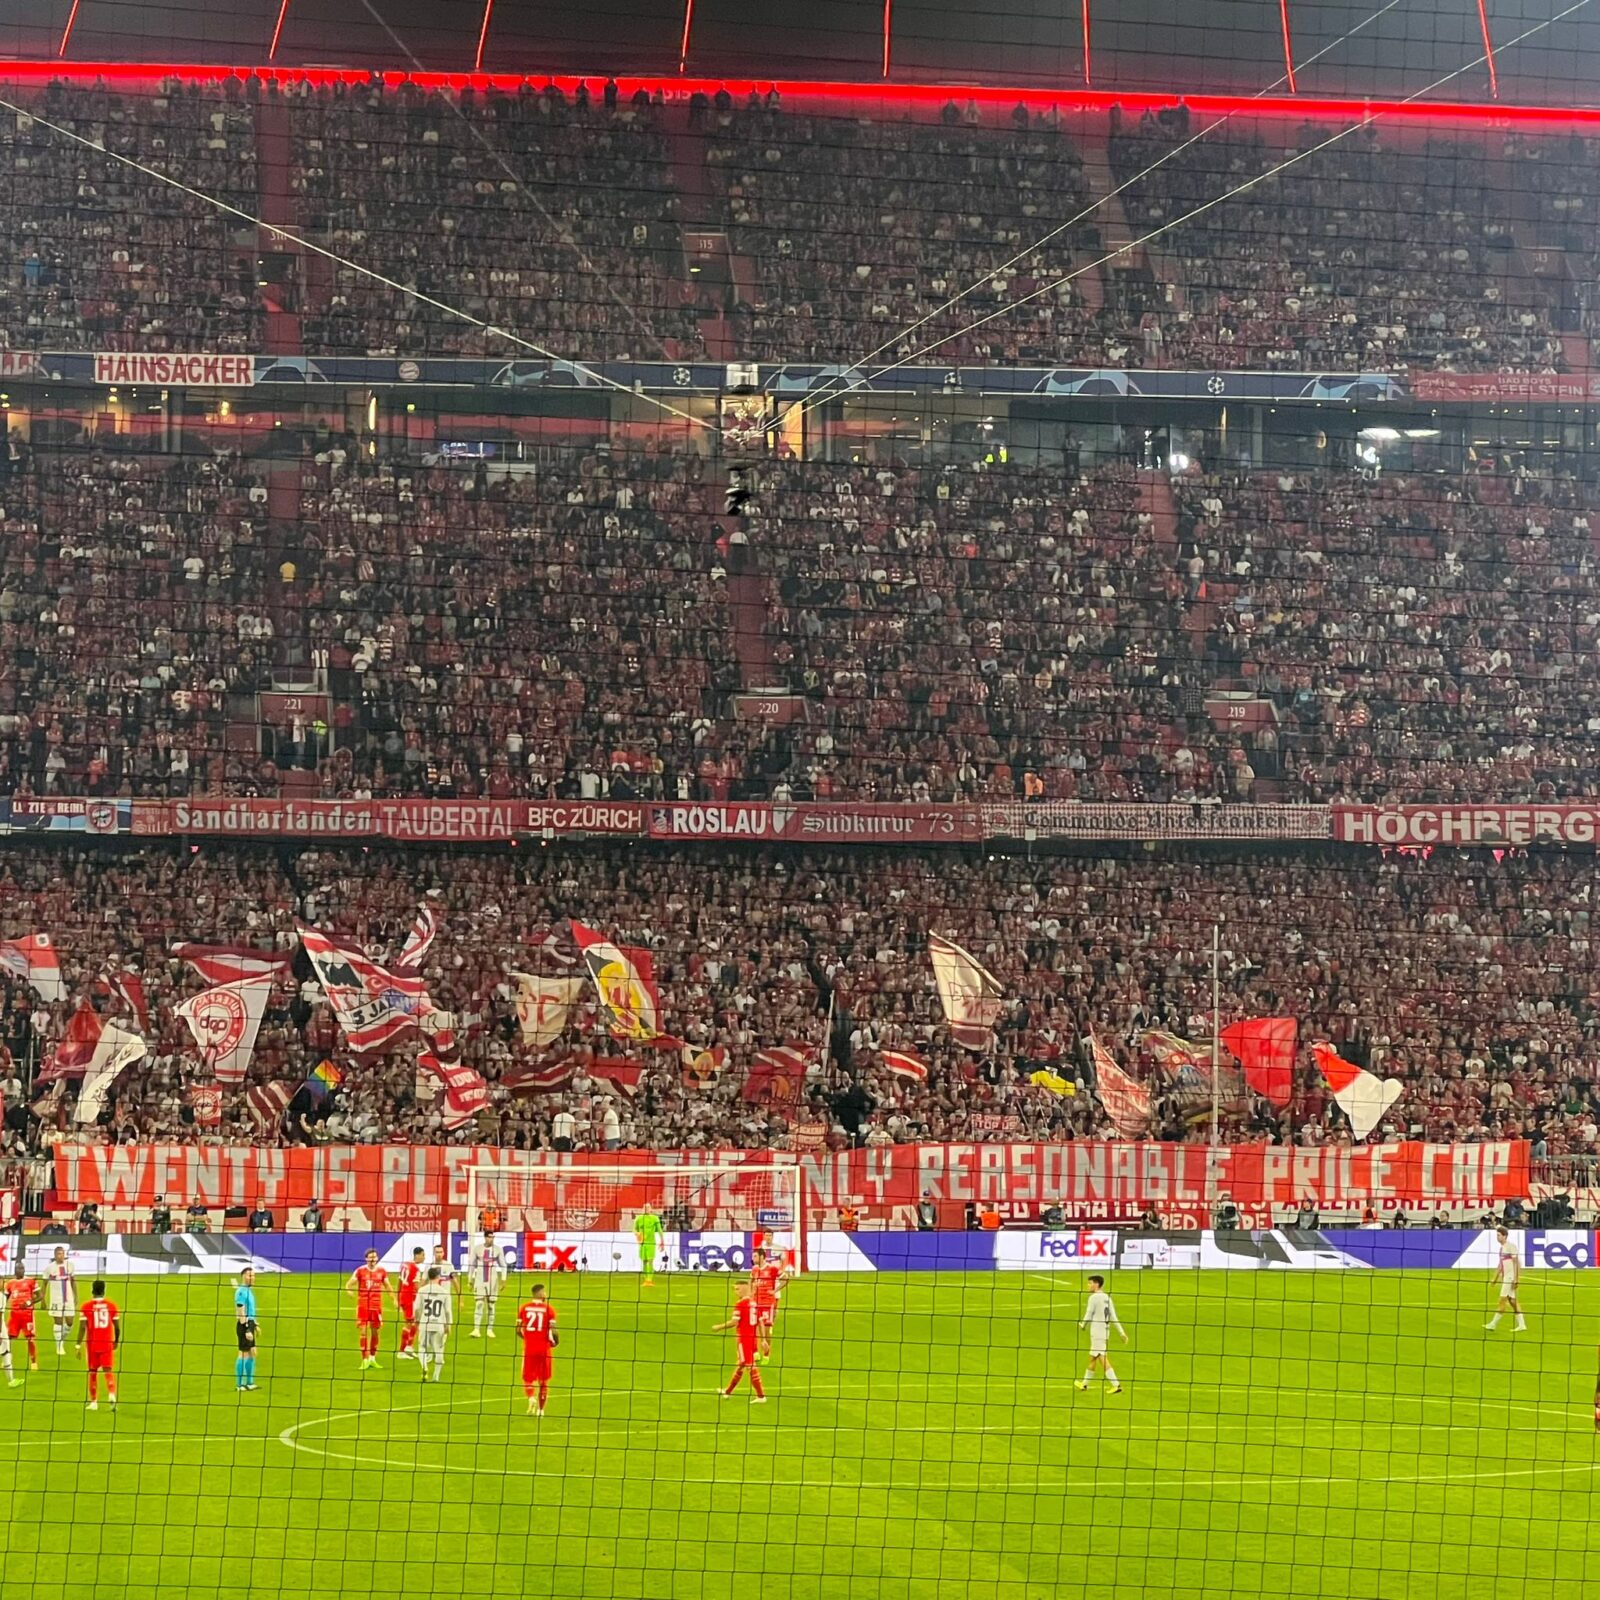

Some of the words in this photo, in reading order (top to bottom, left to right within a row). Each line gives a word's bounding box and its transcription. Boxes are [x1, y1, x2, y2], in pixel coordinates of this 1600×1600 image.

[99, 355, 252, 383] HAINSACKER
[283, 699, 302, 710] 221
[758, 702, 779, 714] 220
[1228, 706, 1246, 718] 219
[175, 801, 372, 831] Sandharlanden
[382, 806, 513, 838] TAUBERTAL
[528, 806, 567, 828] BFC
[570, 805, 641, 829] ZÜRICH
[802, 811, 915, 833] Südkurve
[919, 812, 954, 834] '73
[1023, 810, 1138, 830] Commando
[1343, 808, 1595, 842] HÖCHBERG
[60, 1145, 285, 1204] TWENTY
[312, 1146, 357, 1203] IS
[382, 1147, 573, 1206] PLENTY
[656, 1151, 746, 1207] THE
[918, 1144, 1231, 1200] REASONABLE
[1263, 1144, 1399, 1200] PRICE
[1421, 1142, 1511, 1199] CAP
[384, 1205, 441, 1218] GEGEN
[384, 1220, 441, 1232] RASSISMUS
[451, 1231, 577, 1270] FdEx
[1040, 1231, 1109, 1258] FedEx
[93, 1307, 109, 1329] 19
[424, 1299, 442, 1318] 30
[526, 1311, 544, 1332] 21
